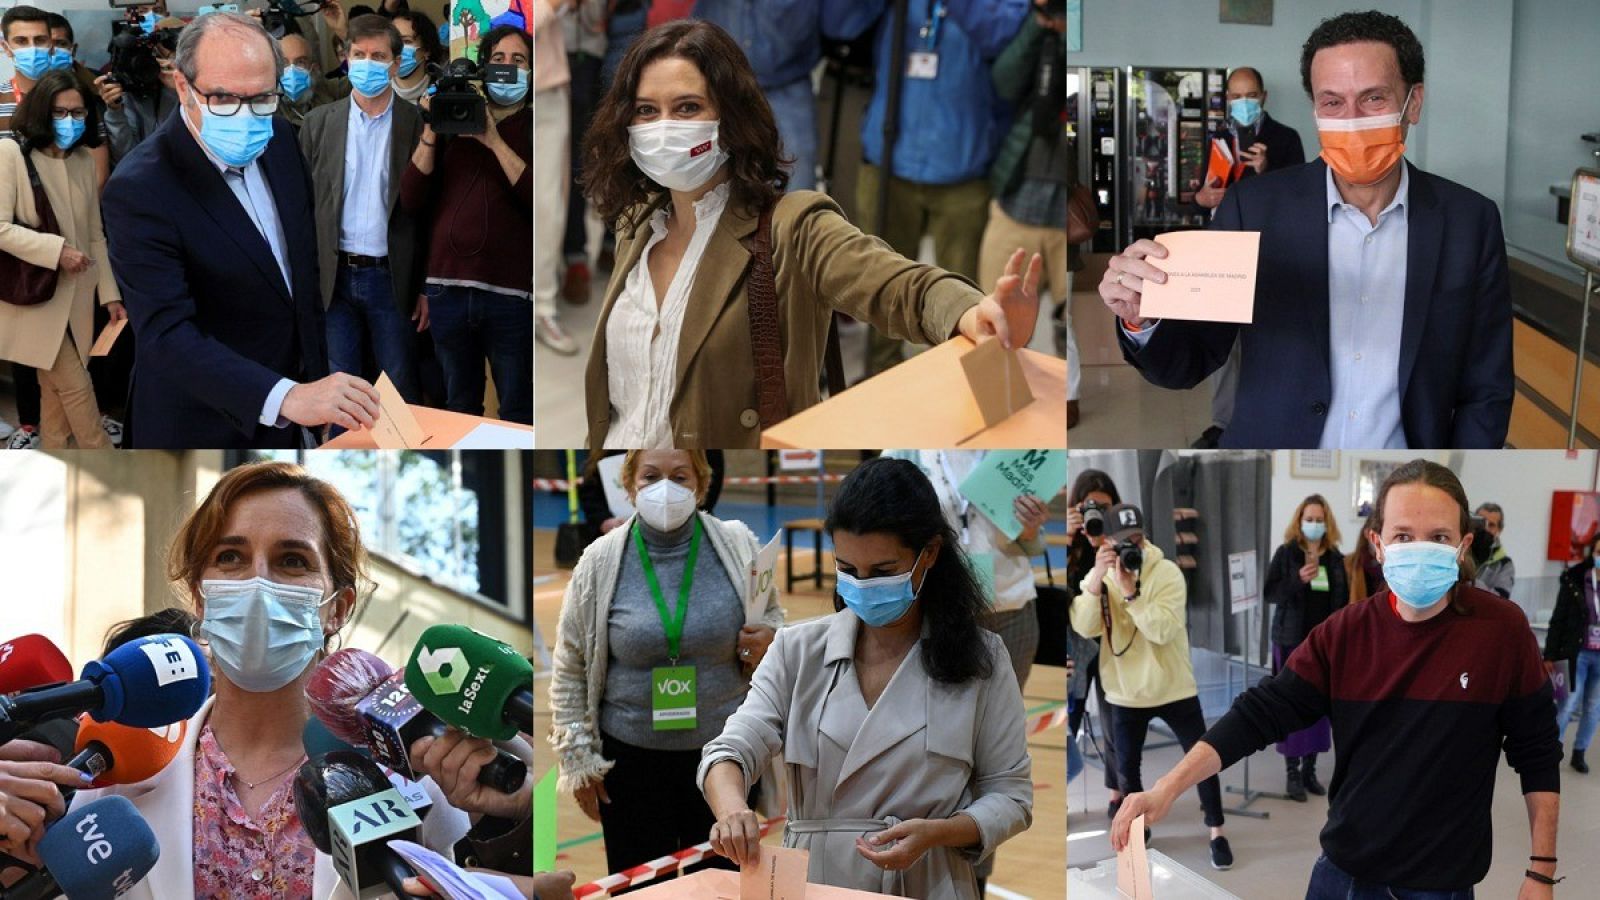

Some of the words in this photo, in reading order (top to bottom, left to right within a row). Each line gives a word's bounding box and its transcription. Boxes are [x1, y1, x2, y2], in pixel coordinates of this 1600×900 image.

[458, 664, 494, 715] laSext
[657, 677, 692, 697] VOX
[75, 812, 113, 865] tve
[351, 799, 409, 835] AR
